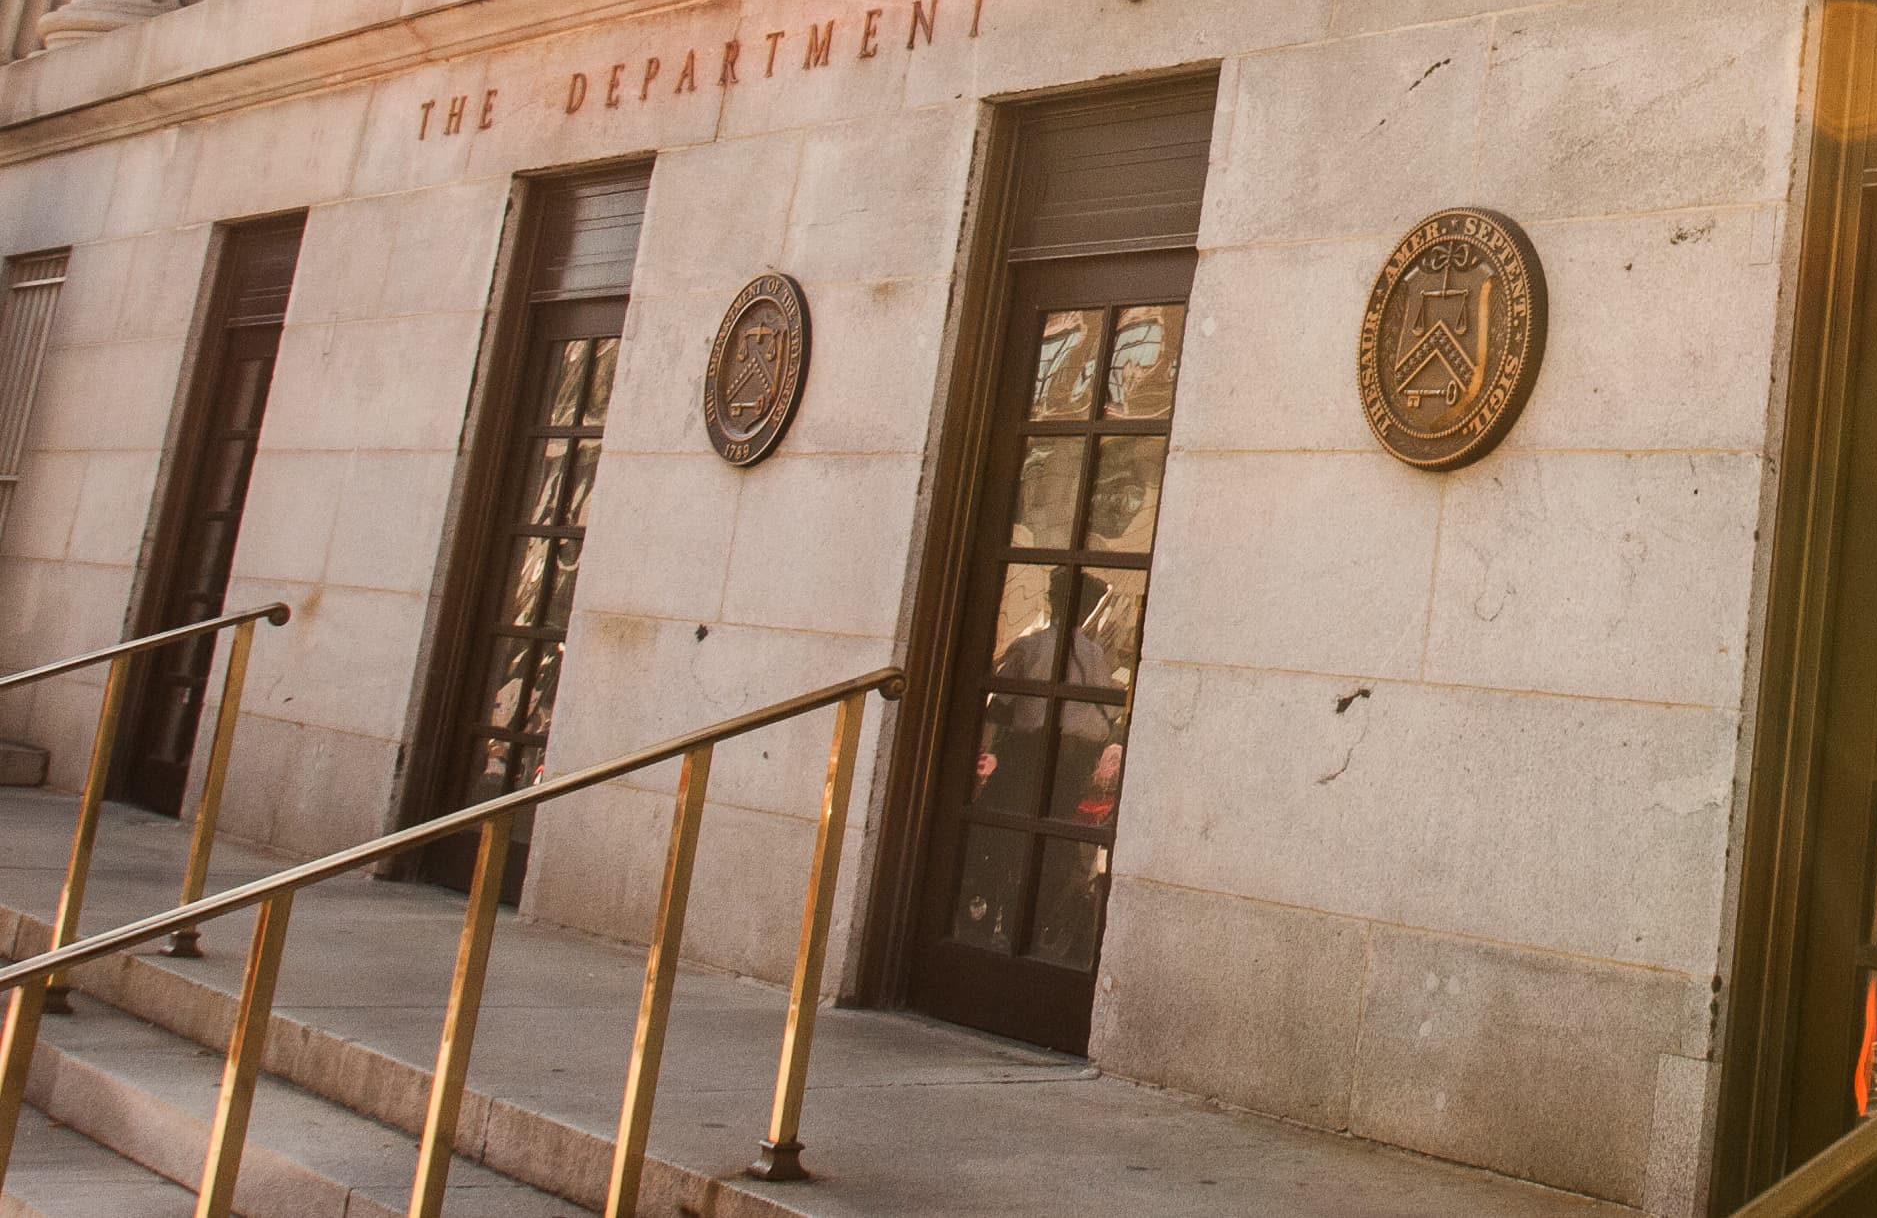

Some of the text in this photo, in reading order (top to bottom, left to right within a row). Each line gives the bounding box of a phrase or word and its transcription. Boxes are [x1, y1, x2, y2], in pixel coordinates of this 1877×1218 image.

[418, 89, 499, 141] THE
[1385, 221, 1447, 286] AMER.
[1464, 216, 1527, 327] SEPTENT.
[767, 280, 781, 296] OF
[781, 289, 799, 321] THE
